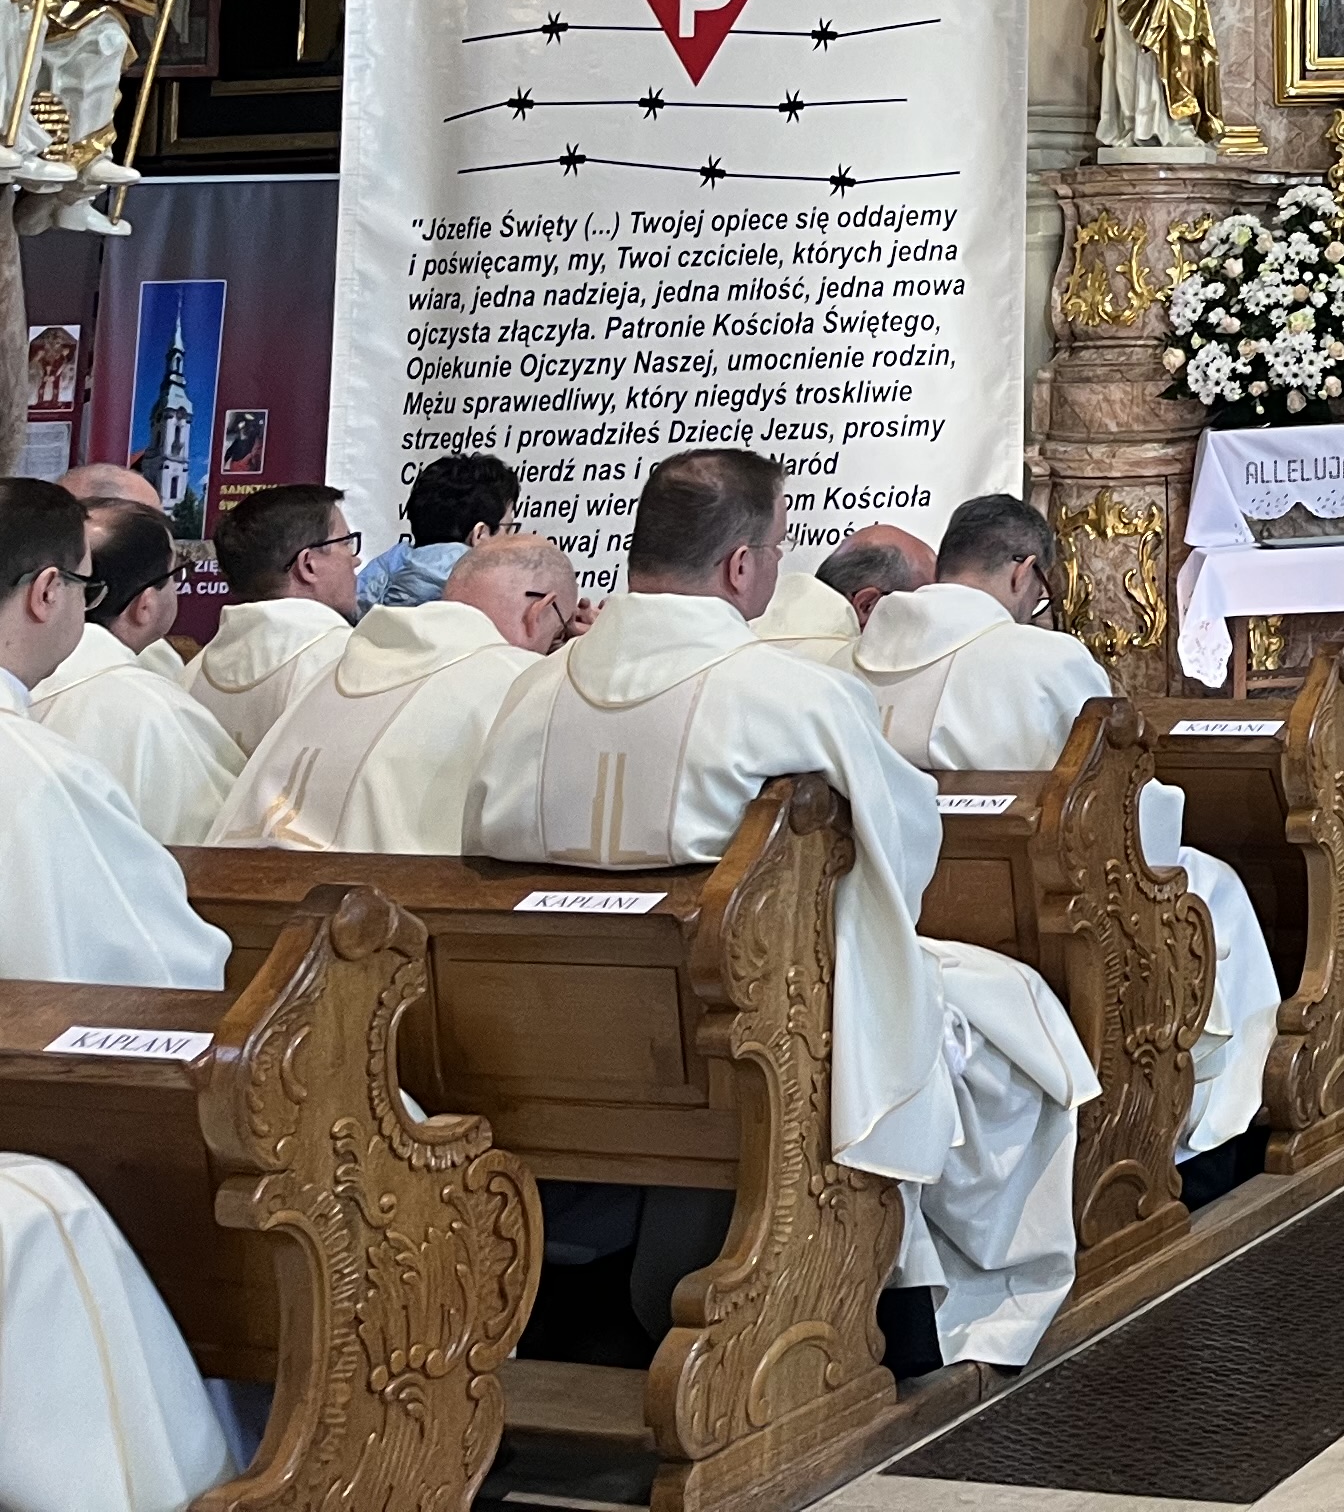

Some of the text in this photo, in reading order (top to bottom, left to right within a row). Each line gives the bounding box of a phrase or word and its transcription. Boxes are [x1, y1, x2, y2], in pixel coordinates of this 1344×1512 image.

[499, 208, 578, 243] Święty
[584, 211, 620, 242] (...)
[630, 209, 705, 240] Twojej
[711, 208, 788, 238] opiece
[795, 206, 830, 235] się
[837, 204, 958, 233] oddajemy
[408, 238, 958, 282] i poświęcamy, my, Twoi czciciele, których jedna
[409, 274, 965, 316] wiara, jedna nadzieja, jedna miłość, jedna mowa
[407, 304, 940, 352] ojczysta złączyła. Patronie Kościoła Świętego,
[406, 343, 955, 386] Opiekunie Ojczyzny Naszej, umocnienie rodzin,
[402, 390, 457, 421] Mężu
[625, 384, 689, 414] który
[694, 381, 787, 413] niegdyś
[795, 379, 913, 405] troskliwie
[401, 414, 946, 455] strzegłeś i prowadziłeś Dziecię Jezus, prosimy
[582, 466, 626, 481] nas
[634, 456, 643, 480] i
[823, 484, 932, 511] Kościoła
